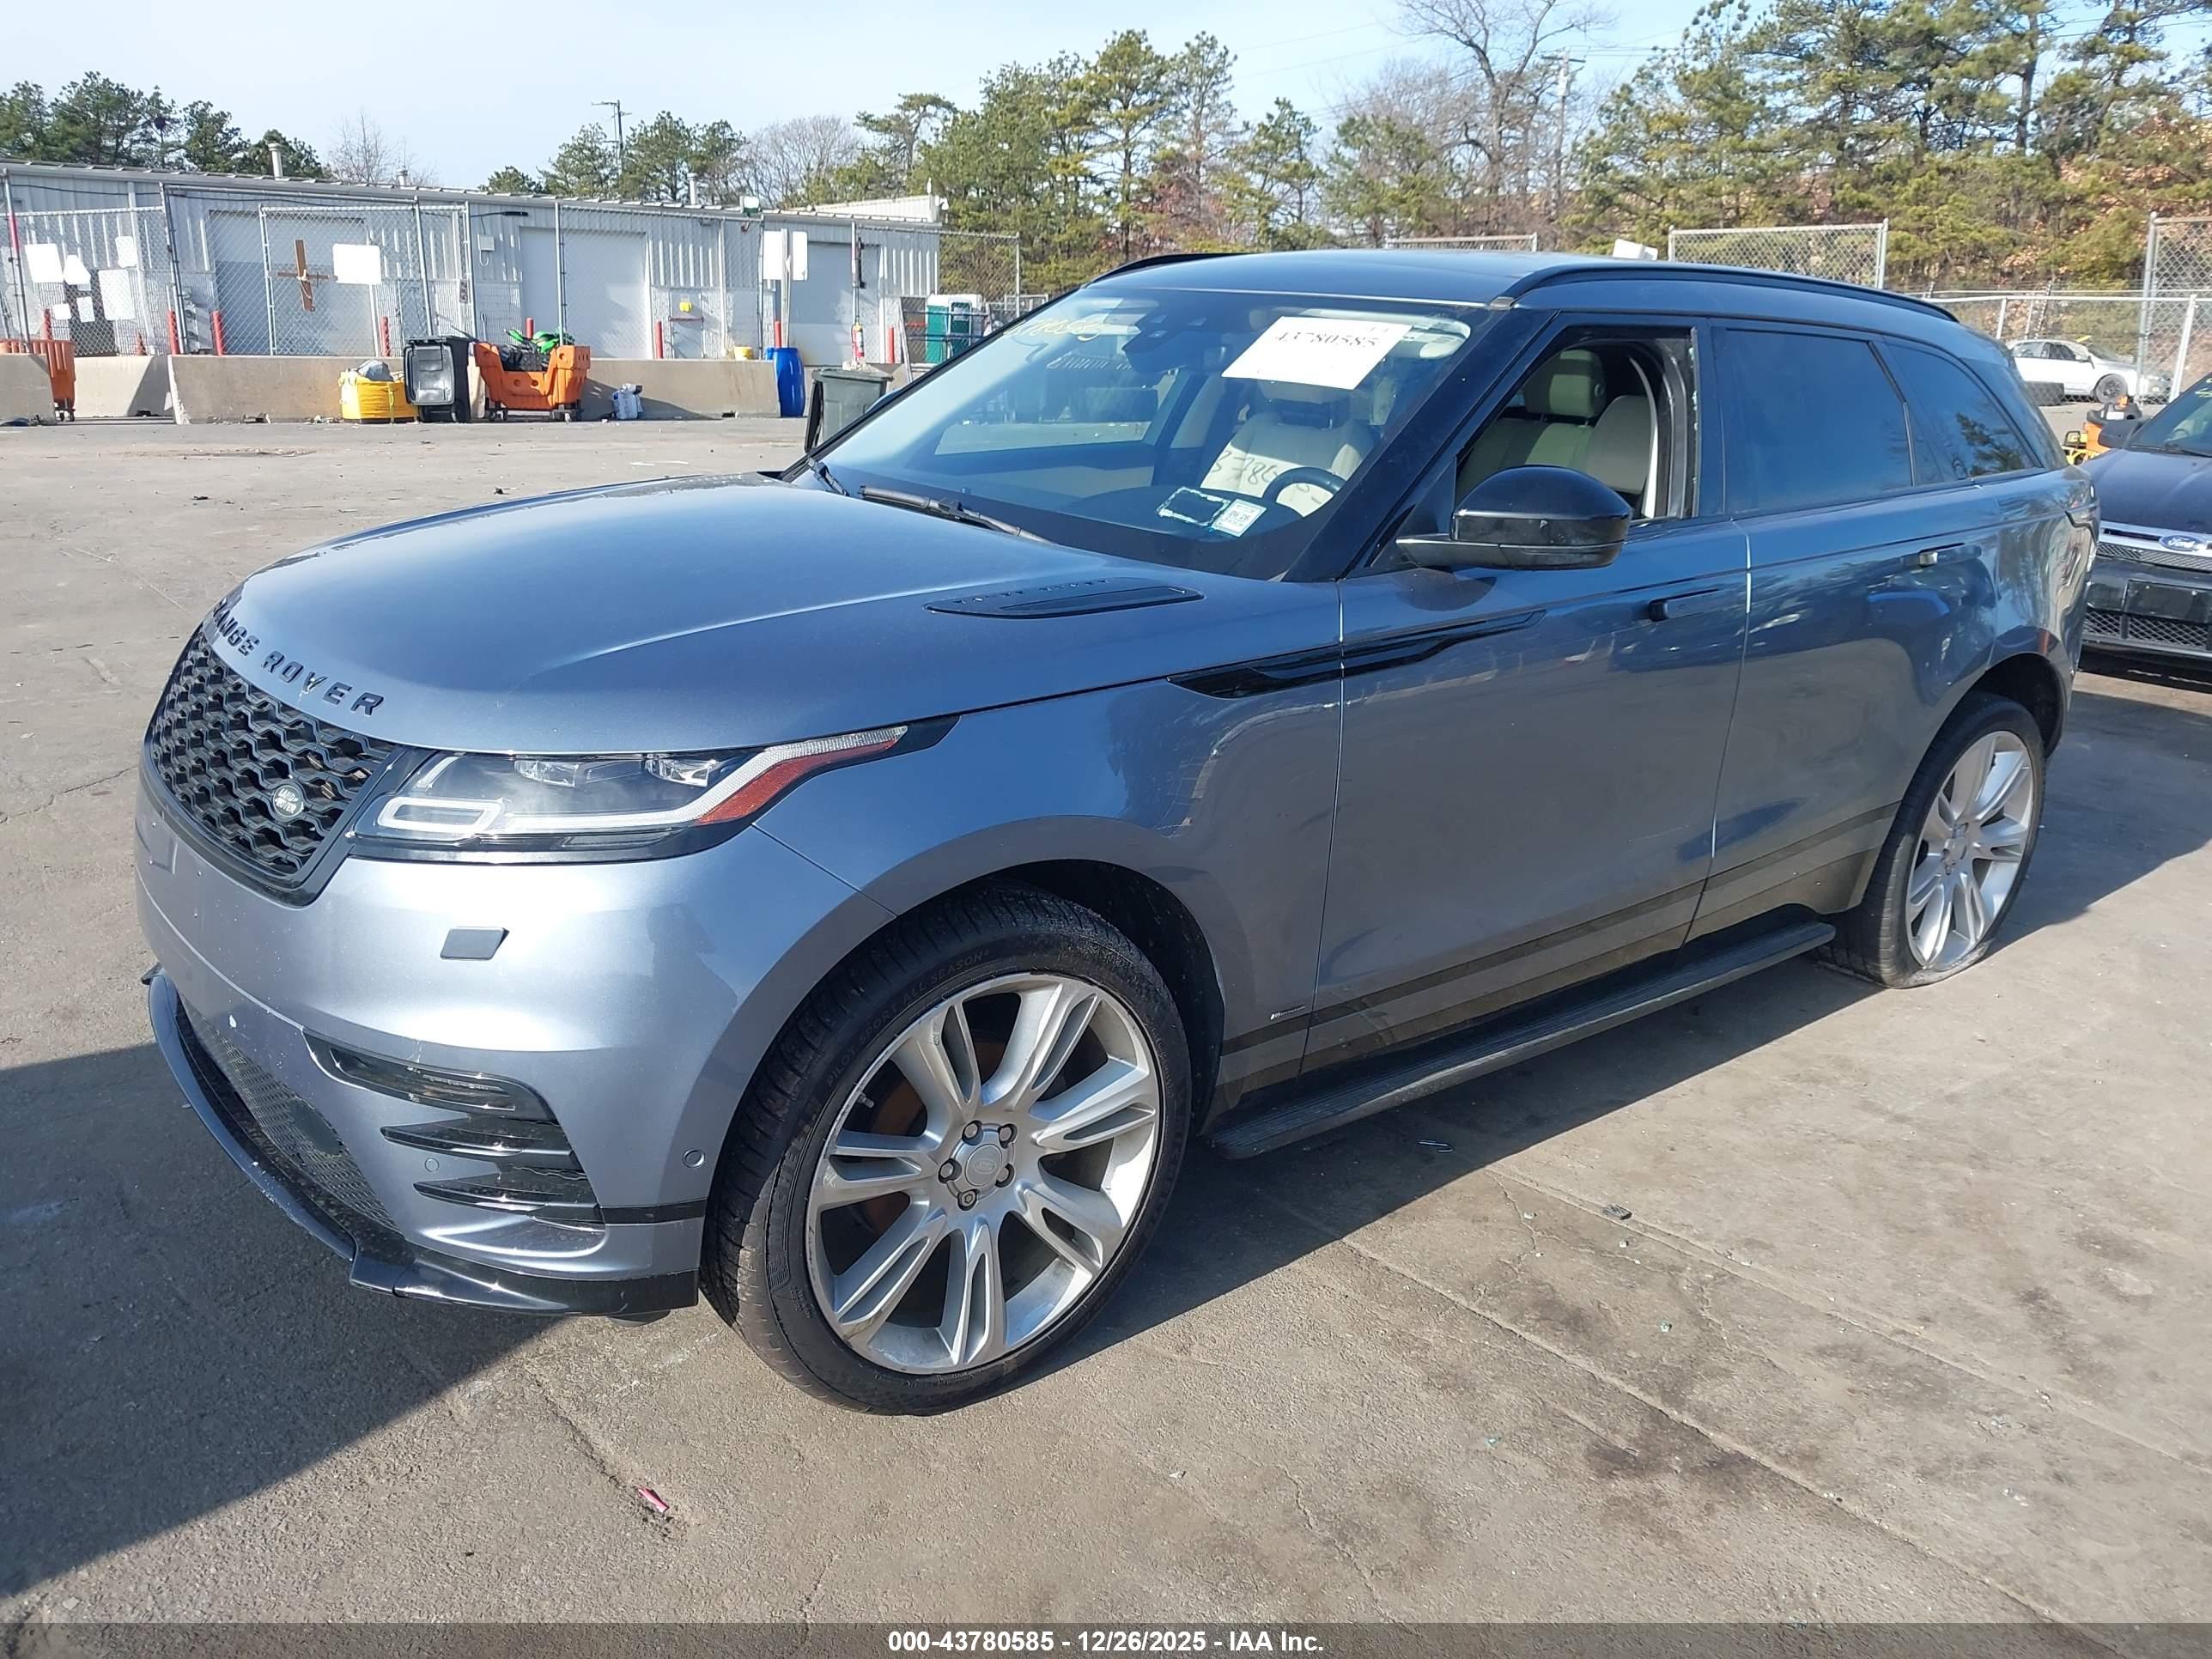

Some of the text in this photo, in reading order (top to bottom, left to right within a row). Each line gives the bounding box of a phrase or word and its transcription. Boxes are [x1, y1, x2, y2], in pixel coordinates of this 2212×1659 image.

[213, 600, 385, 716] RANGE ROVER
[275, 798, 298, 814] ROVER
[276, 787, 299, 802] LAND
[931, 951, 983, 982] SEASON
